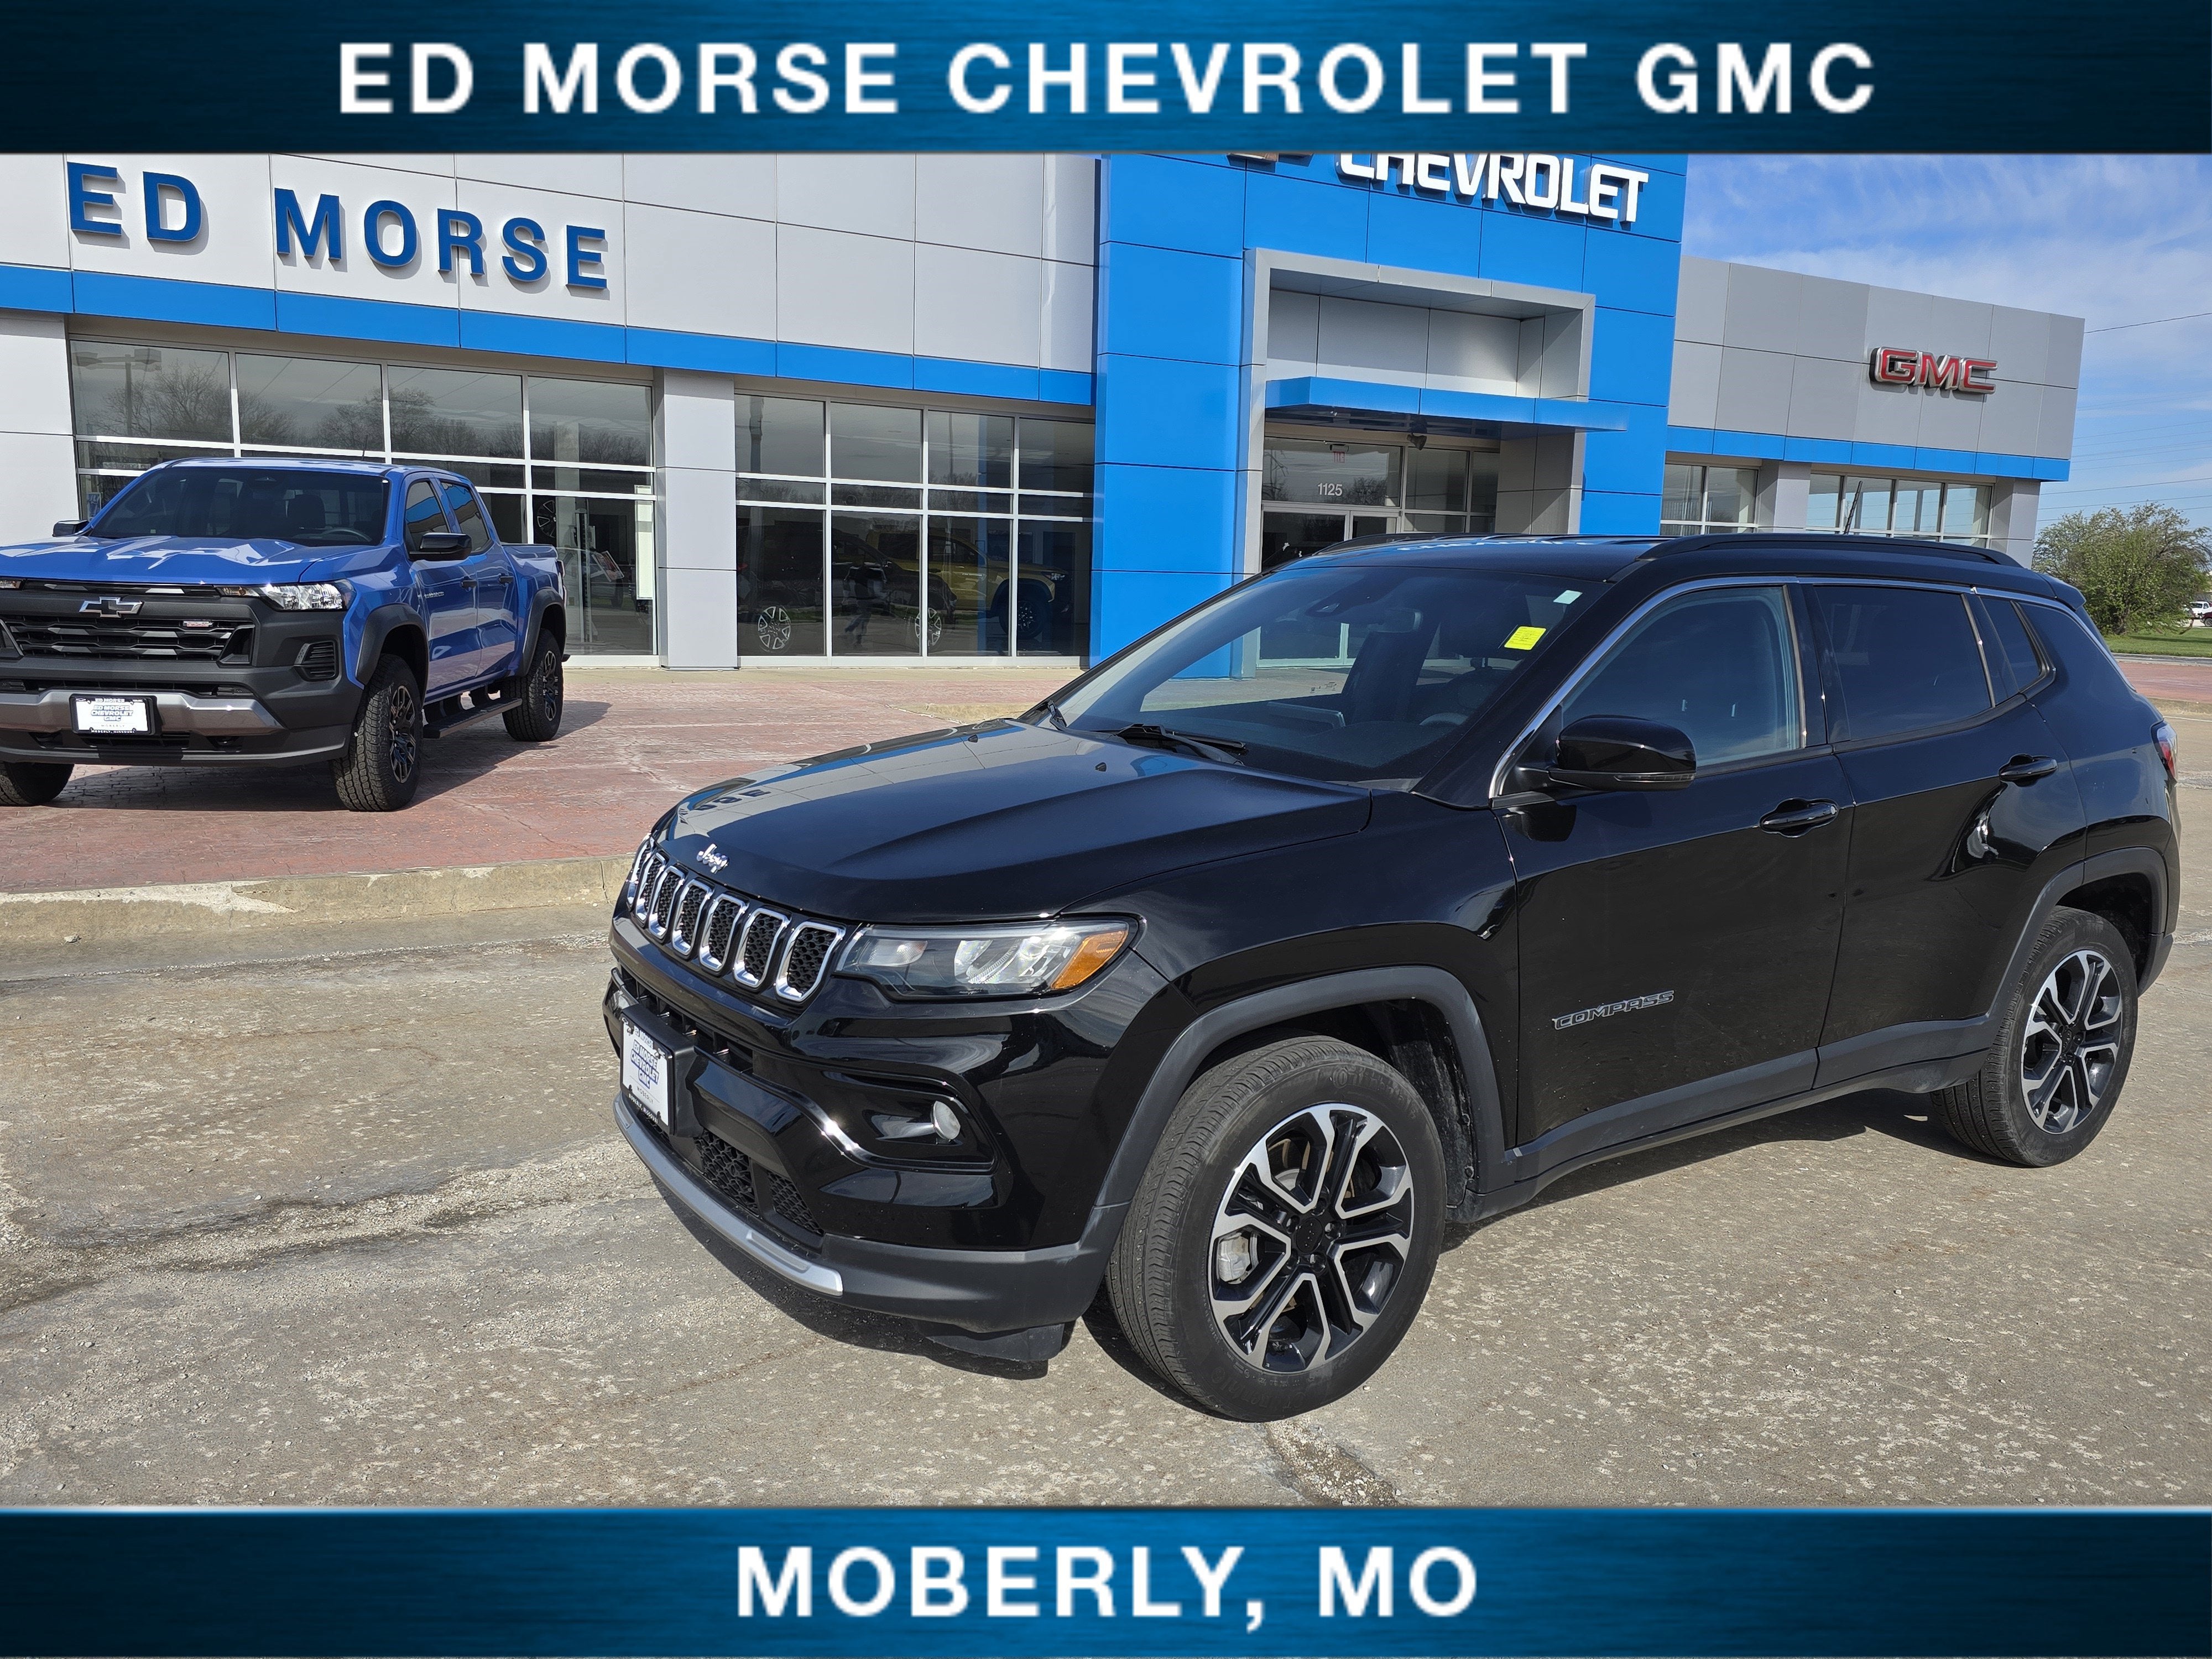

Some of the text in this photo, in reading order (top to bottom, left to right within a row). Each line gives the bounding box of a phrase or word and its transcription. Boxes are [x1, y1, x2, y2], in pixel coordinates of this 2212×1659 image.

[67, 161, 607, 290] ED MORSE
[1870, 347, 1998, 394] GMC
[1317, 483, 1343, 496] 1125
[696, 843, 729, 874] Jeep
[1552, 990, 1674, 1030] COMPASS
[630, 1048, 660, 1085] CHEVROLET
[633, 1039, 640, 1054] ED
[639, 1045, 658, 1070] MORSE
[638, 1069, 651, 1089] GMC
